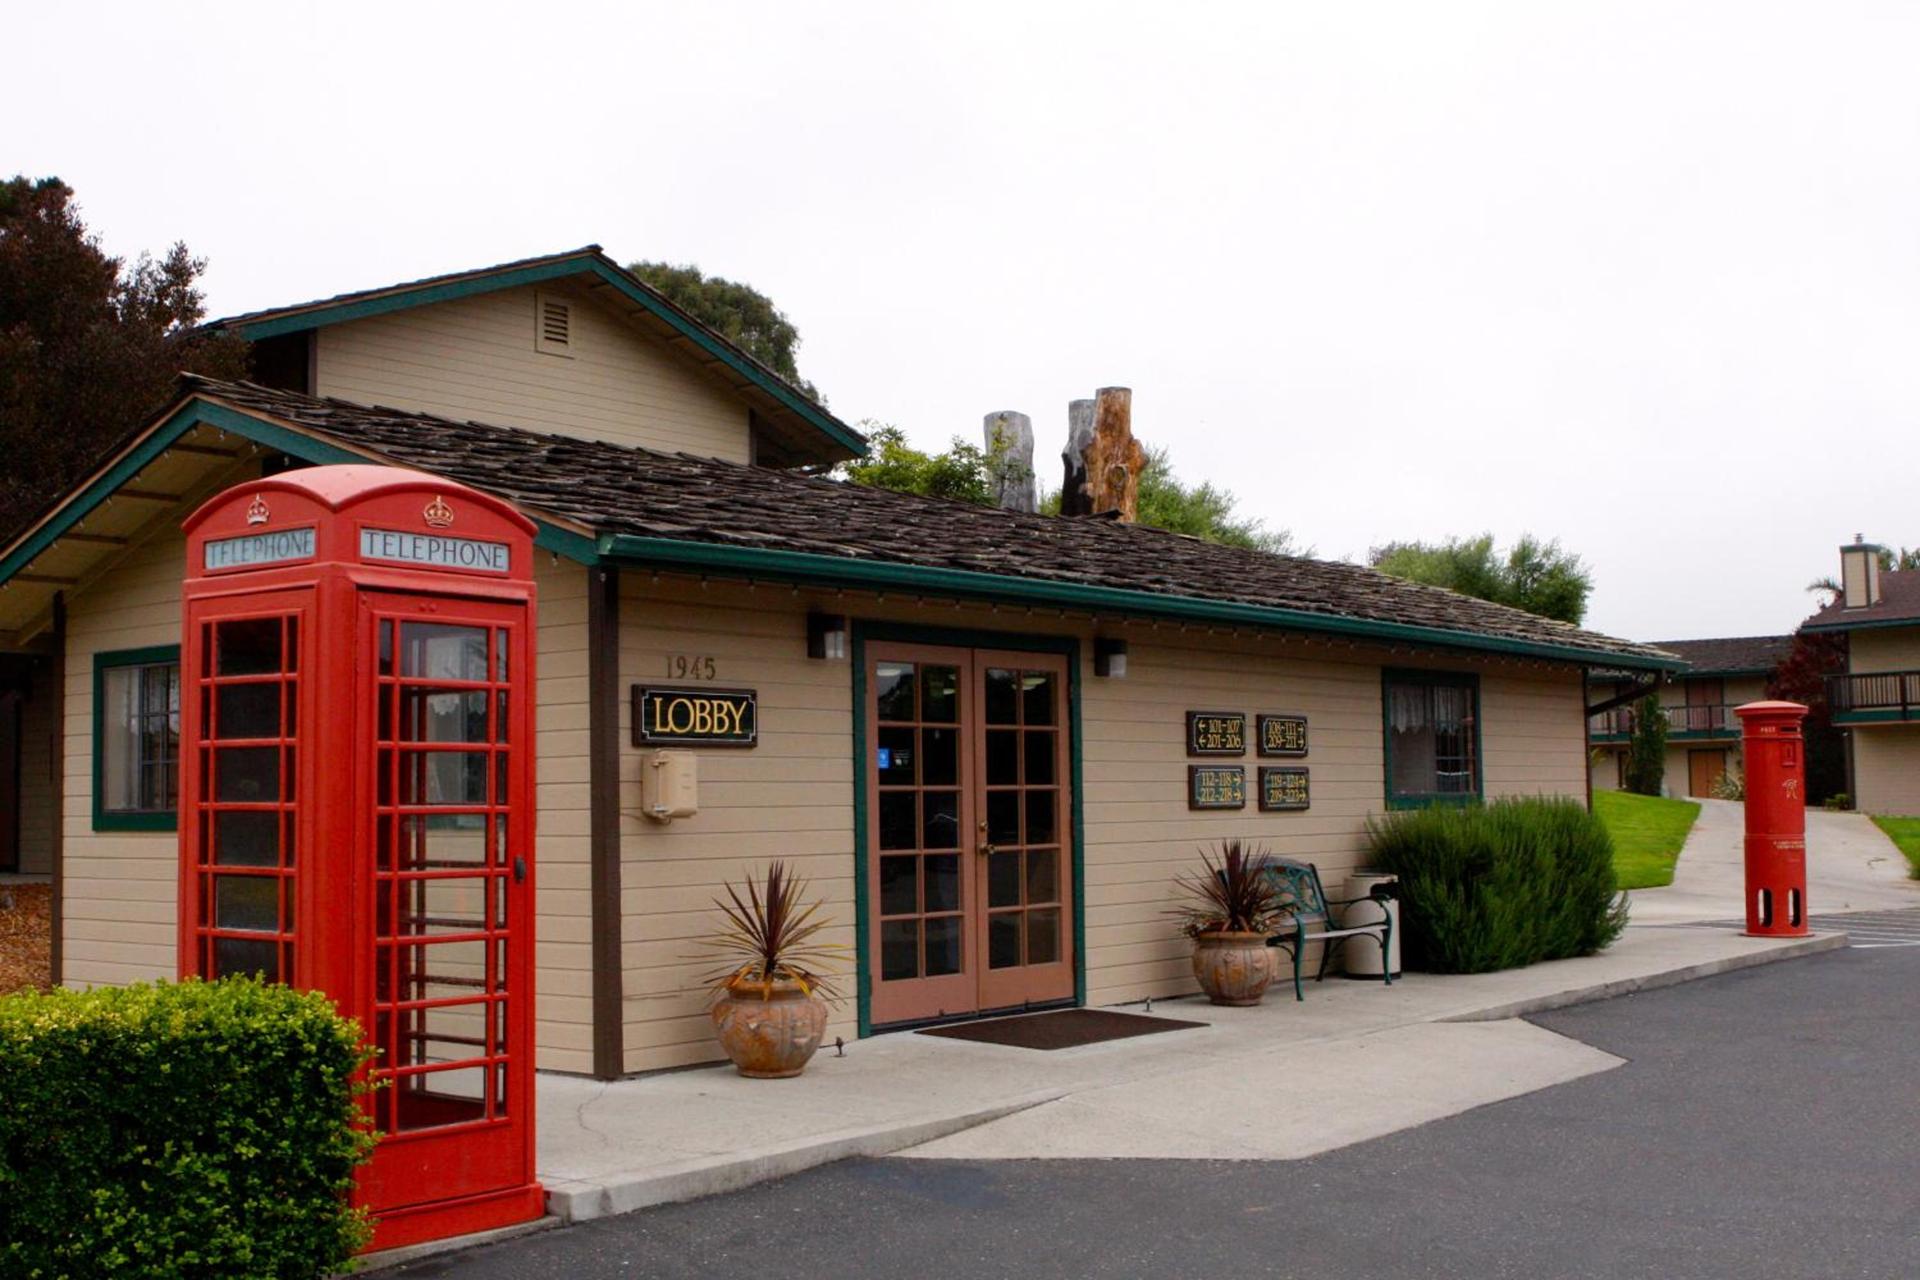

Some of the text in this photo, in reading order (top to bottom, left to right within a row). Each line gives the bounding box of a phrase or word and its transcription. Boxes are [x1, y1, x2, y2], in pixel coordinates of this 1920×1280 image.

[209, 529, 312, 566] TELEPHONE
[365, 530, 505, 569] TELEPHONE
[665, 655, 716, 680] 1945
[653, 697, 748, 734] LOBBY
